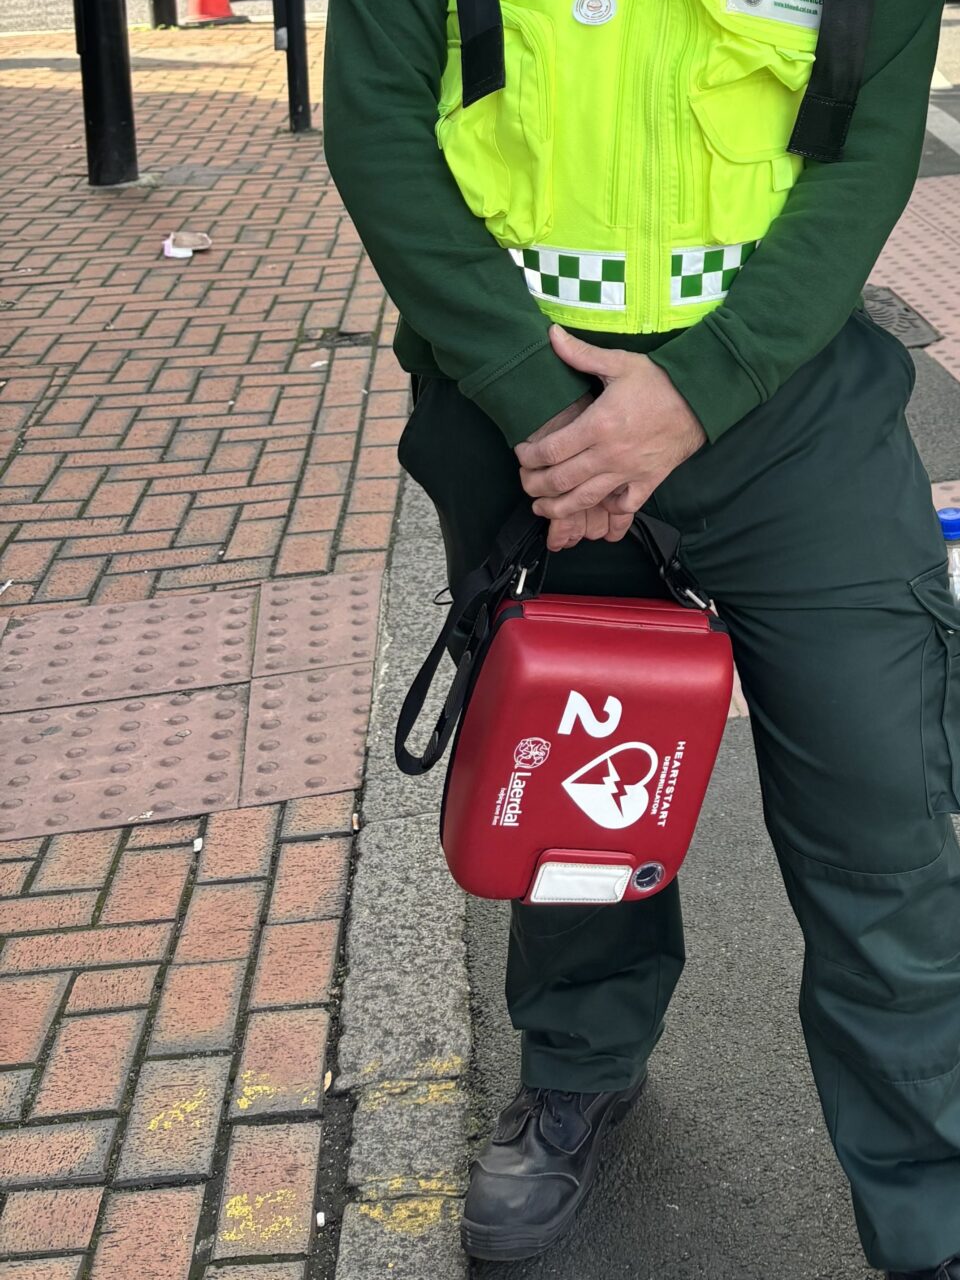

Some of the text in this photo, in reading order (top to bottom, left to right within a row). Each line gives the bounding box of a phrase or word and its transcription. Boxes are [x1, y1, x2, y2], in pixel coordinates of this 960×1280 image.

[557, 689, 623, 738] 2
[502, 771, 532, 827] Laerdal
[650, 755, 671, 816] DEFIBRILLATOR
[657, 740, 687, 828] HEARTSTART
